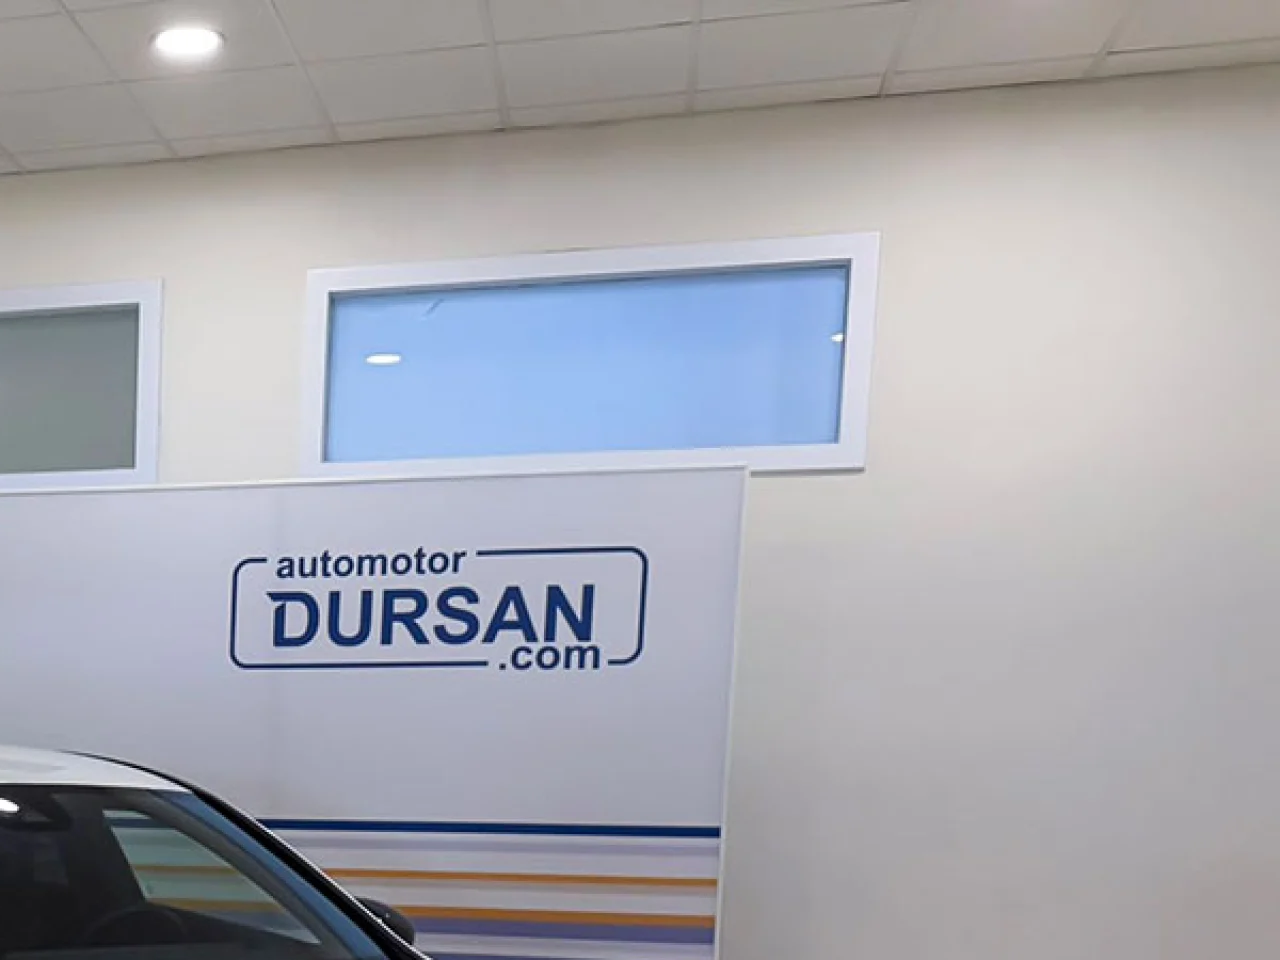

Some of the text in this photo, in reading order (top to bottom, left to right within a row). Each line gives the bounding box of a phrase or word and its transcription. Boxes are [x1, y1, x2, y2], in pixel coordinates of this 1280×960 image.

[276, 547, 467, 578] automotor
[266, 584, 595, 647] DURSAN
[498, 645, 600, 671] .com
